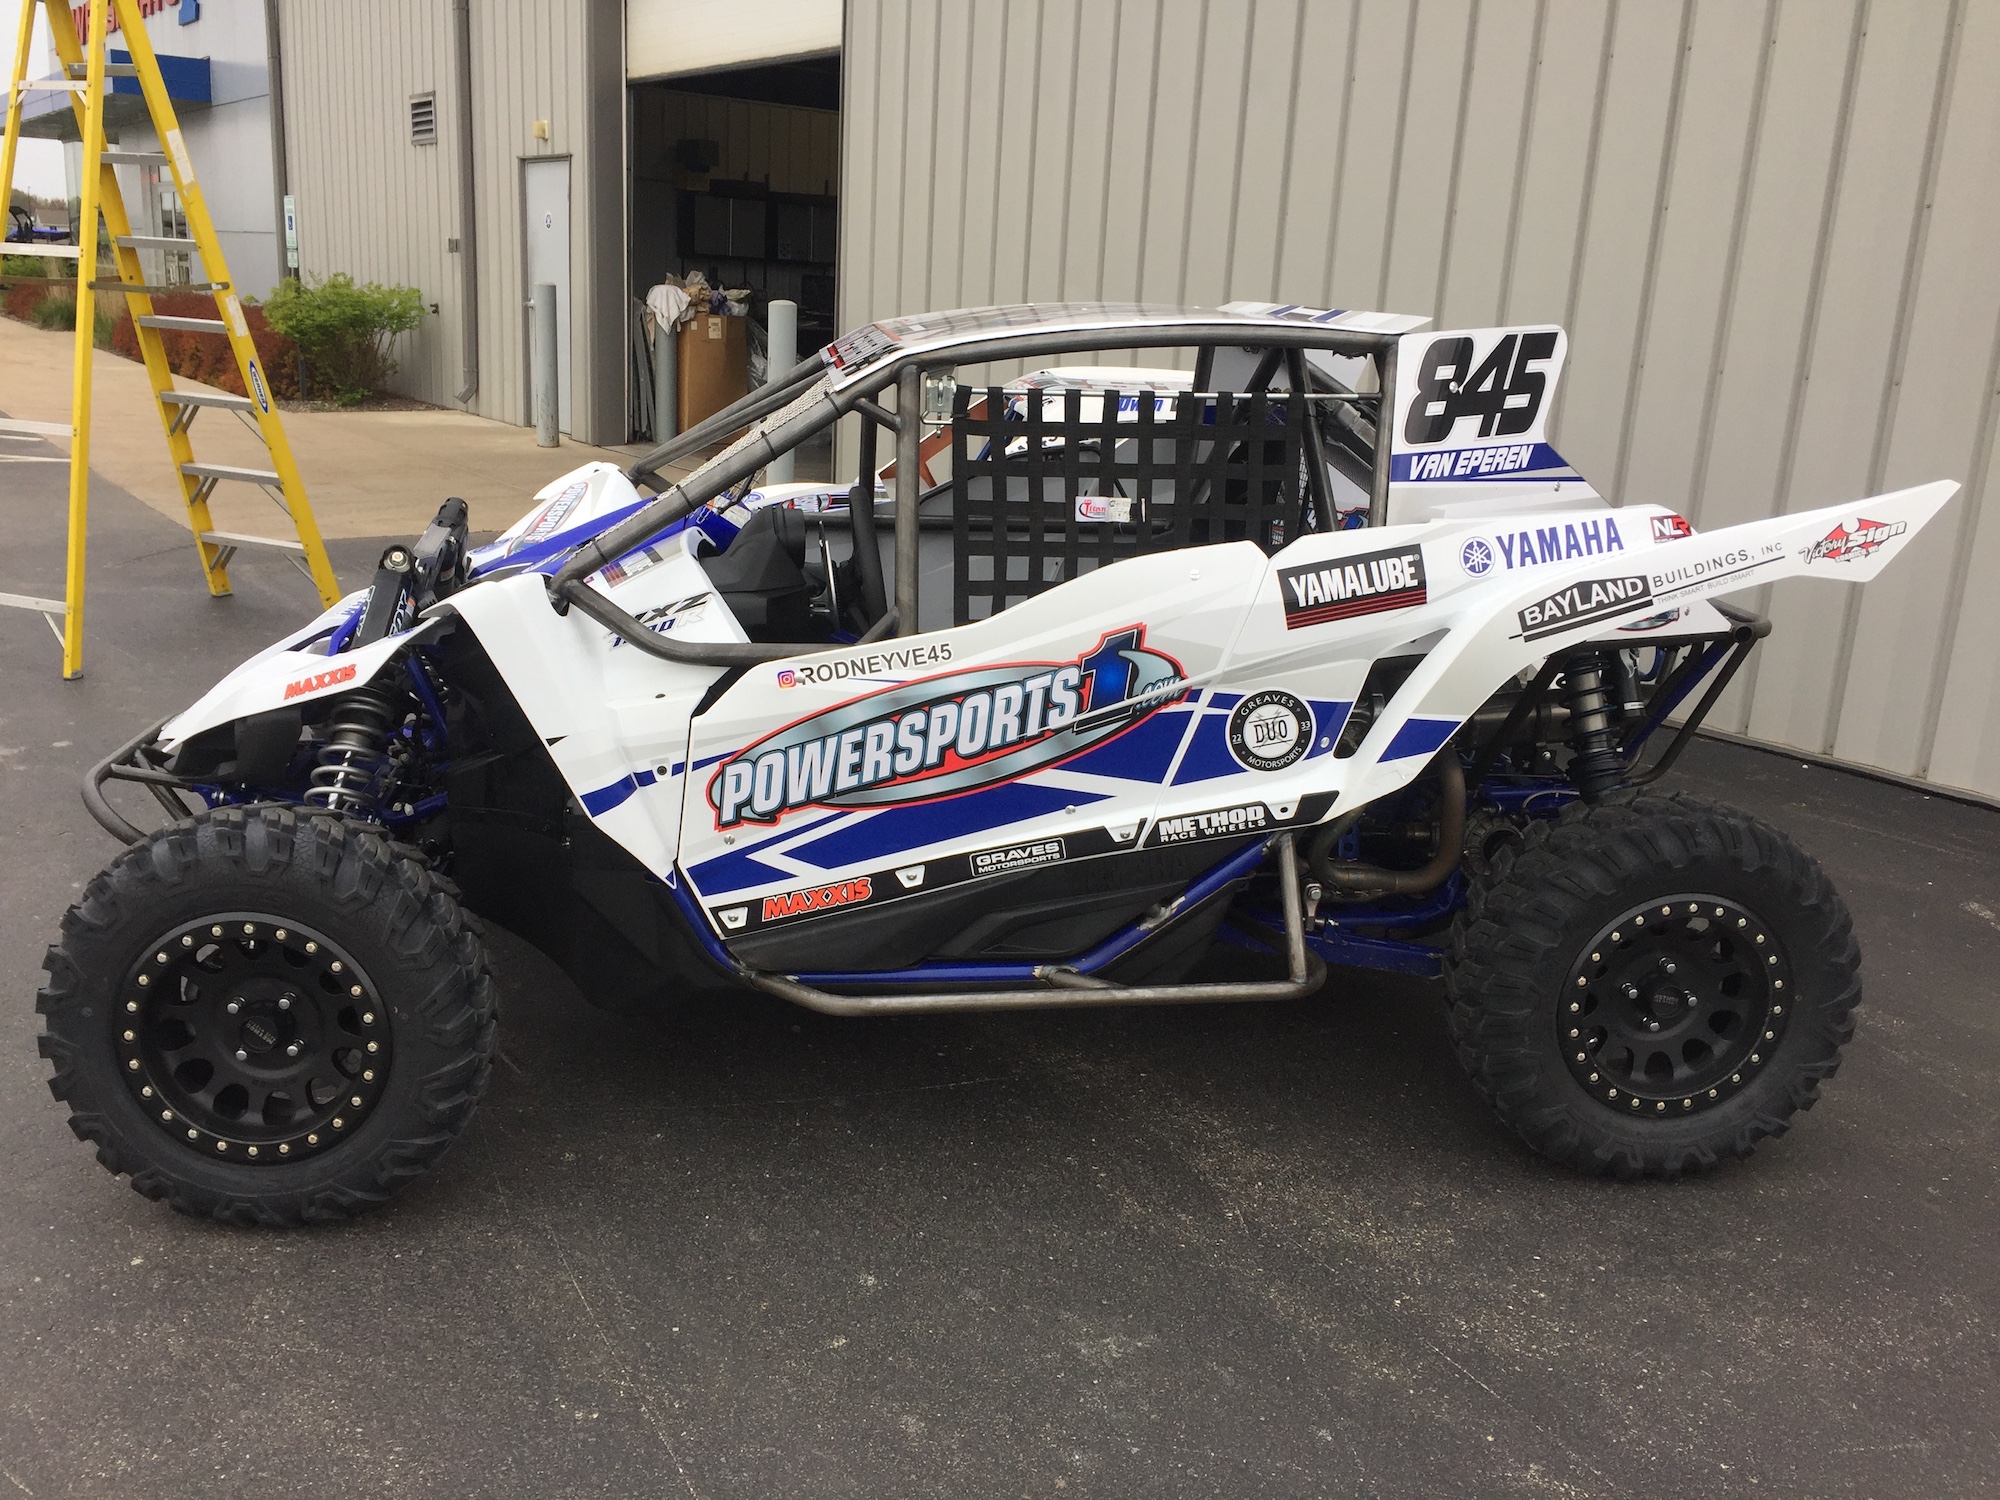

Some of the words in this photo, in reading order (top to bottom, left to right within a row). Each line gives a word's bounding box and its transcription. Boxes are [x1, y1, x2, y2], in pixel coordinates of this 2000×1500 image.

[1403, 332, 1559, 446] 845
[1409, 453, 1457, 481] VAN
[1453, 444, 1535, 476] EPEREN
[1495, 517, 1625, 569] YAMAHA
[1799, 536, 1847, 565] Victory
[1846, 521, 1907, 549] Sign
[1288, 554, 1419, 607] YAMALUBE
[1522, 577, 1644, 627] BAYLAND
[1652, 549, 1756, 588] BUILDINGS,
[1761, 542, 1784, 556] INC
[1656, 594, 1682, 605] THINK
[1679, 585, 1705, 598] SMART
[1707, 578, 1729, 590] BUILD
[1730, 569, 1756, 583] SMART
[284, 663, 358, 701] MAXXIS
[799, 644, 953, 686] RODNEYVE45
[1240, 694, 1295, 716] GREAVES
[1232, 733, 1242, 744] 22
[1253, 719, 1288, 743] DUO
[1300, 720, 1311, 731] 33
[1247, 745, 1303, 769] MOTORSPORTS
[1158, 805, 1266, 836] METHOD
[1160, 830, 1198, 843] RACE
[1204, 819, 1267, 836] WHEELS
[976, 842, 1061, 866] GRAVES
[978, 852, 1062, 874] MOTORSPORTS
[763, 877, 873, 921] MAXXIS
